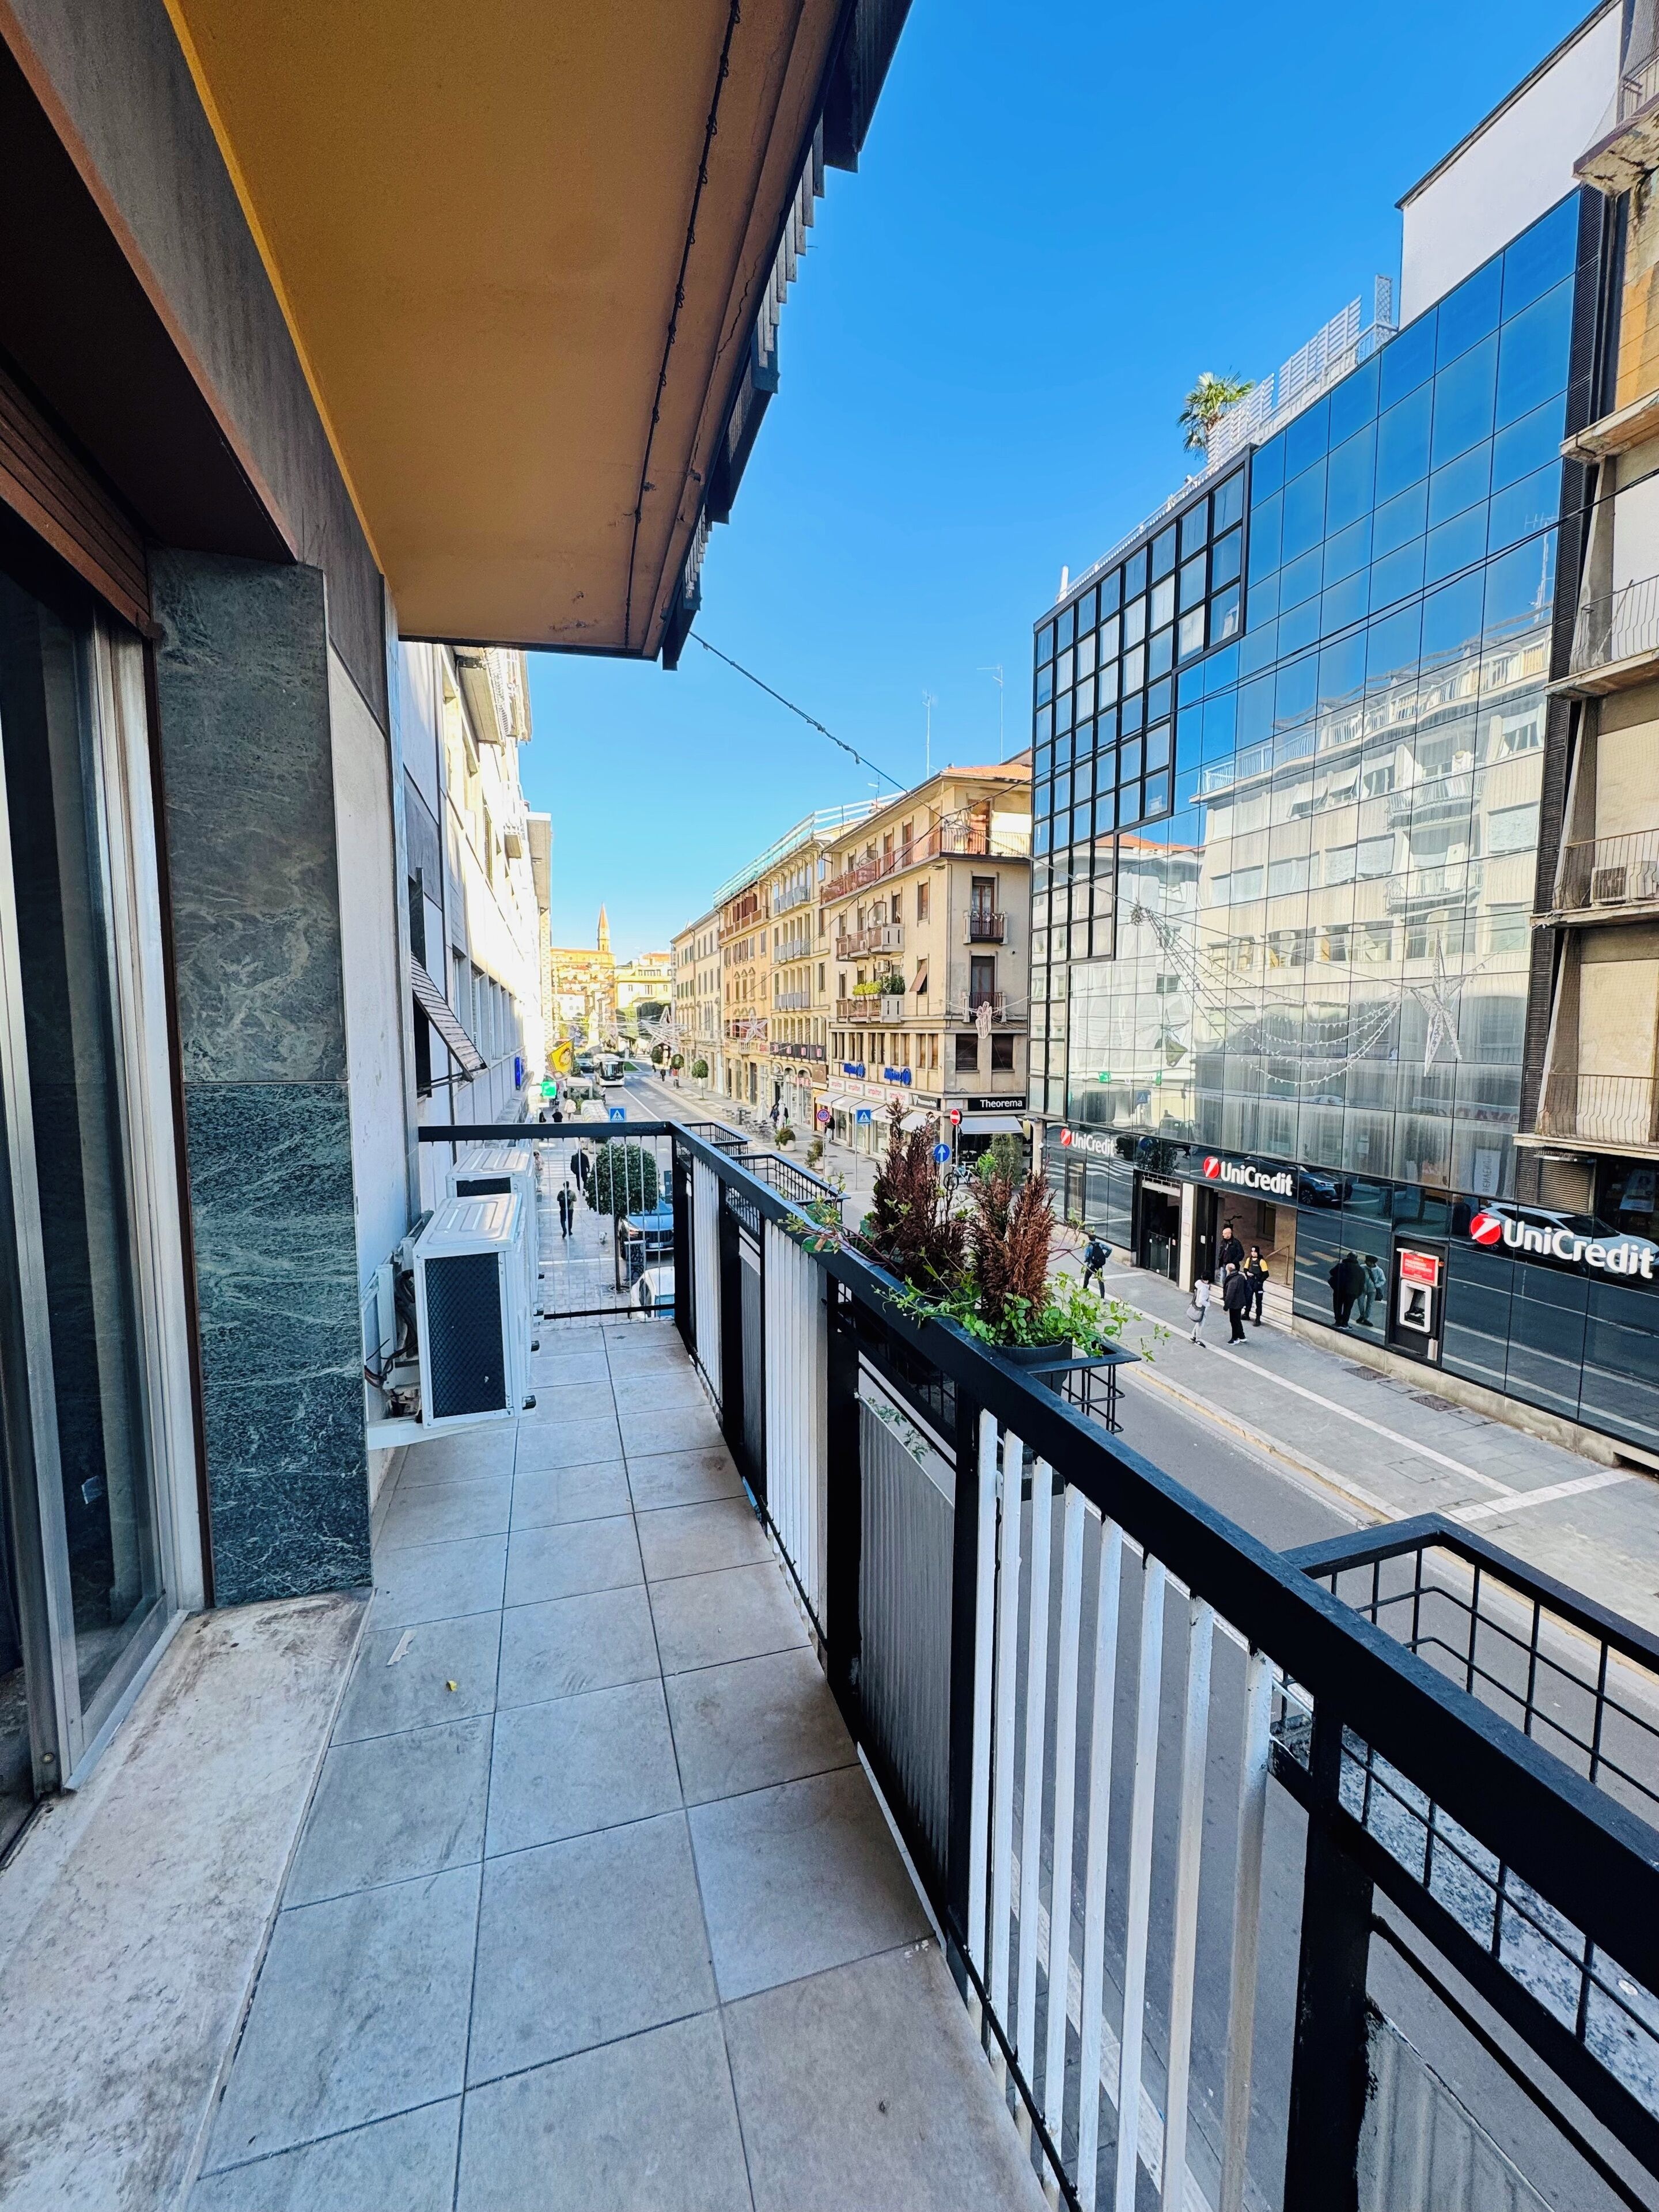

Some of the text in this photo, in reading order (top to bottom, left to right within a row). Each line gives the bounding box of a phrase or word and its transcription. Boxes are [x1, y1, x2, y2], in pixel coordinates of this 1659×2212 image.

[980, 1099, 1022, 1108] Theorema
[1071, 1131, 1115, 1156] UniCredit
[1221, 1161, 1293, 1196] UniCredit
[1503, 1219, 1654, 1279] UniCredit
